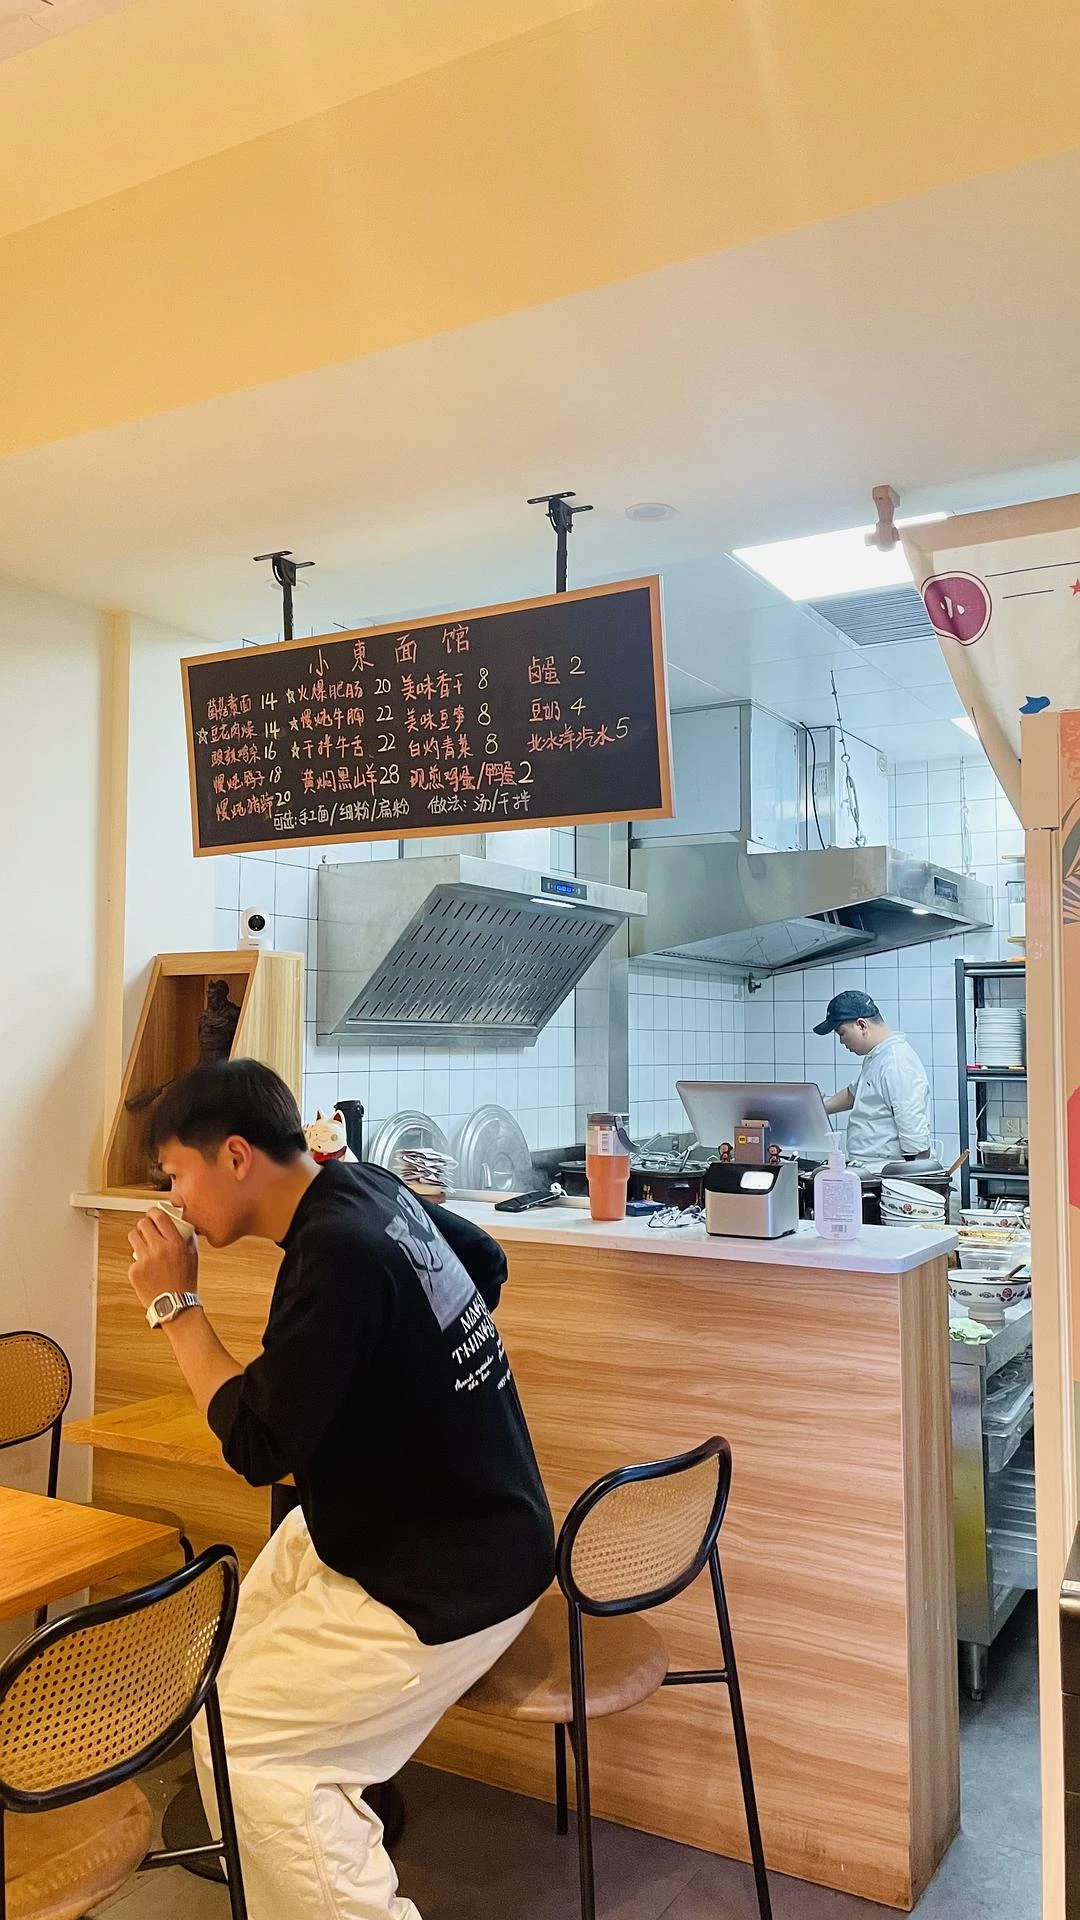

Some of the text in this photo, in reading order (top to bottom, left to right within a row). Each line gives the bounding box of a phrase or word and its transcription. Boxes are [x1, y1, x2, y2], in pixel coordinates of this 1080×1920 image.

[528, 655, 586, 684] 卤蛋 2
[298, 678, 391, 702] 火爆肥肠 20
[401, 667, 489, 701] 美味香干 8
[261, 692, 278, 711] 14
[529, 697, 586, 722] 豆奶 4
[300, 705, 394, 731] 慢炖牛腩 22
[478, 702, 491, 726] 8
[264, 720, 281, 740] 14
[527, 716, 630, 753] 北冰洋汽水 5
[264, 741, 277, 760] 16
[302, 733, 396, 759] 干拌牛舌 22
[408, 733, 498, 760] 白灼青菜 8
[269, 765, 282, 784] 18
[302, 762, 400, 796] 黄焖黑山羊 28
[518, 760, 534, 784] 2
[275, 790, 291, 806] 20
